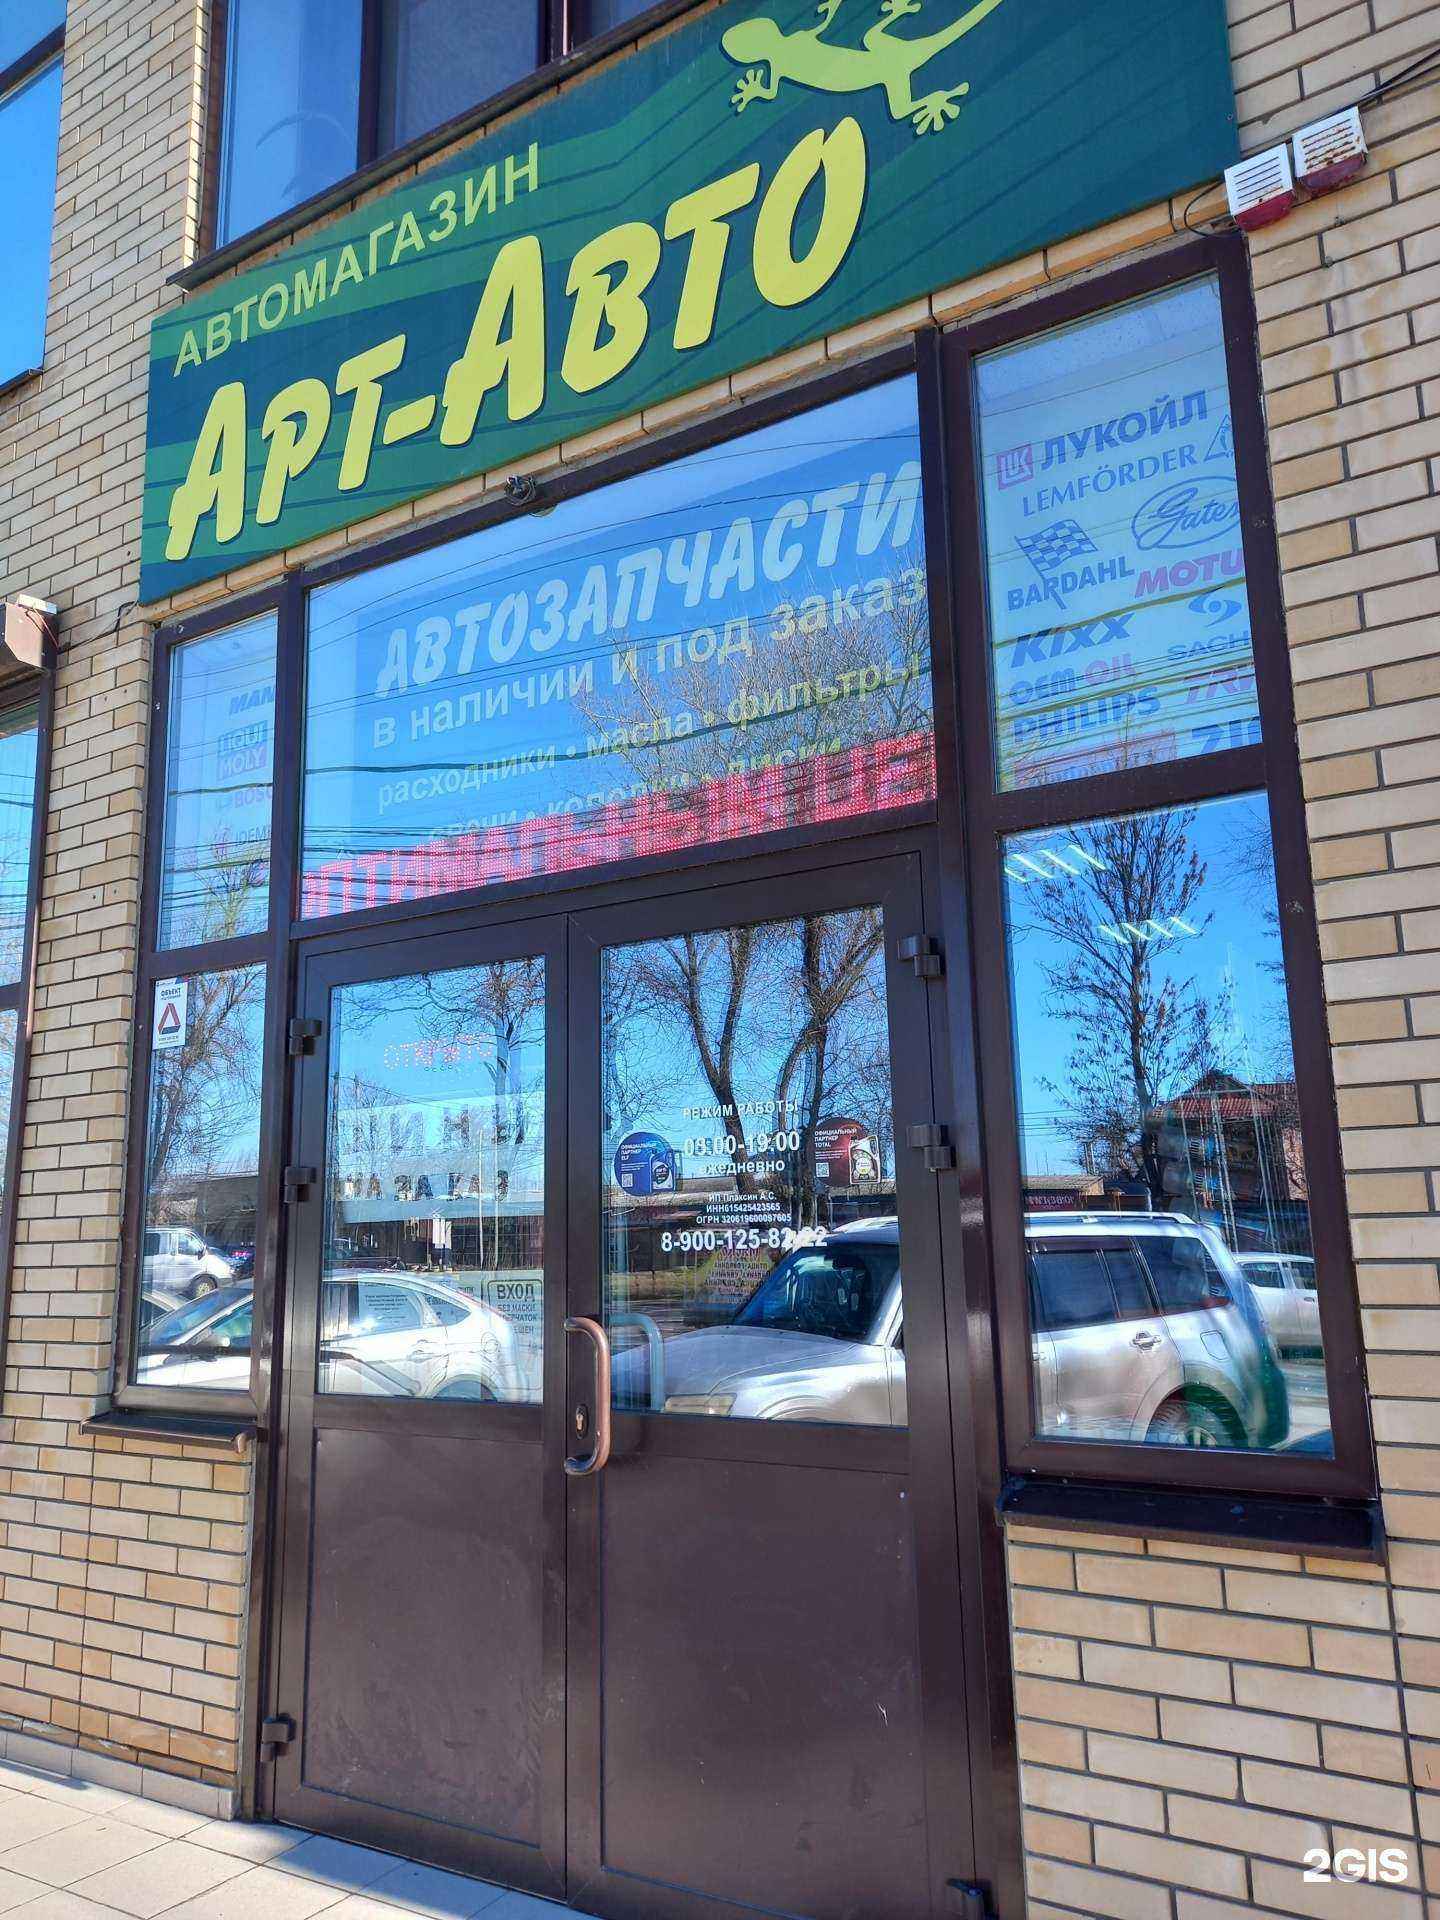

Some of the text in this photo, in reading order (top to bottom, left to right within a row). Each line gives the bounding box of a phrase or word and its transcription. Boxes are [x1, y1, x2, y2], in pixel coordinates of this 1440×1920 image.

[173, 142, 539, 377] АВТОМАГАЗИН
[165, 116, 868, 561] АРТ-АВТО
[1041, 390, 1208, 470] ЛУКОЙЛ
[1023, 444, 1197, 517] LEMFÖRDER
[376, 461, 921, 697] АВТОЗАПЧАСТИ
[1007, 556, 1135, 611] BARDAHL
[1134, 548, 1245, 599] MOTU
[410, 661, 593, 741] наличии
[656, 616, 752, 673] под
[770, 568, 927, 641] заказ
[1011, 612, 1135, 668] KIXX
[1167, 630, 1250, 661] SACH
[230, 686, 275, 716] MAN
[1013, 686, 1161, 743] PHILIPS
[378, 653, 921, 814] расходники масла фильтры
[218, 745, 267, 780] MOLY
[812, 731, 937, 825] ЦЕ
[682, 1099, 798, 1119] РЕЖИМ РАБОТЫ
[661, 1226, 828, 1252] 8-900-125-8222
[696, 1215, 719, 1224] ОГРН
[497, 1283, 535, 1302] ВХОД
